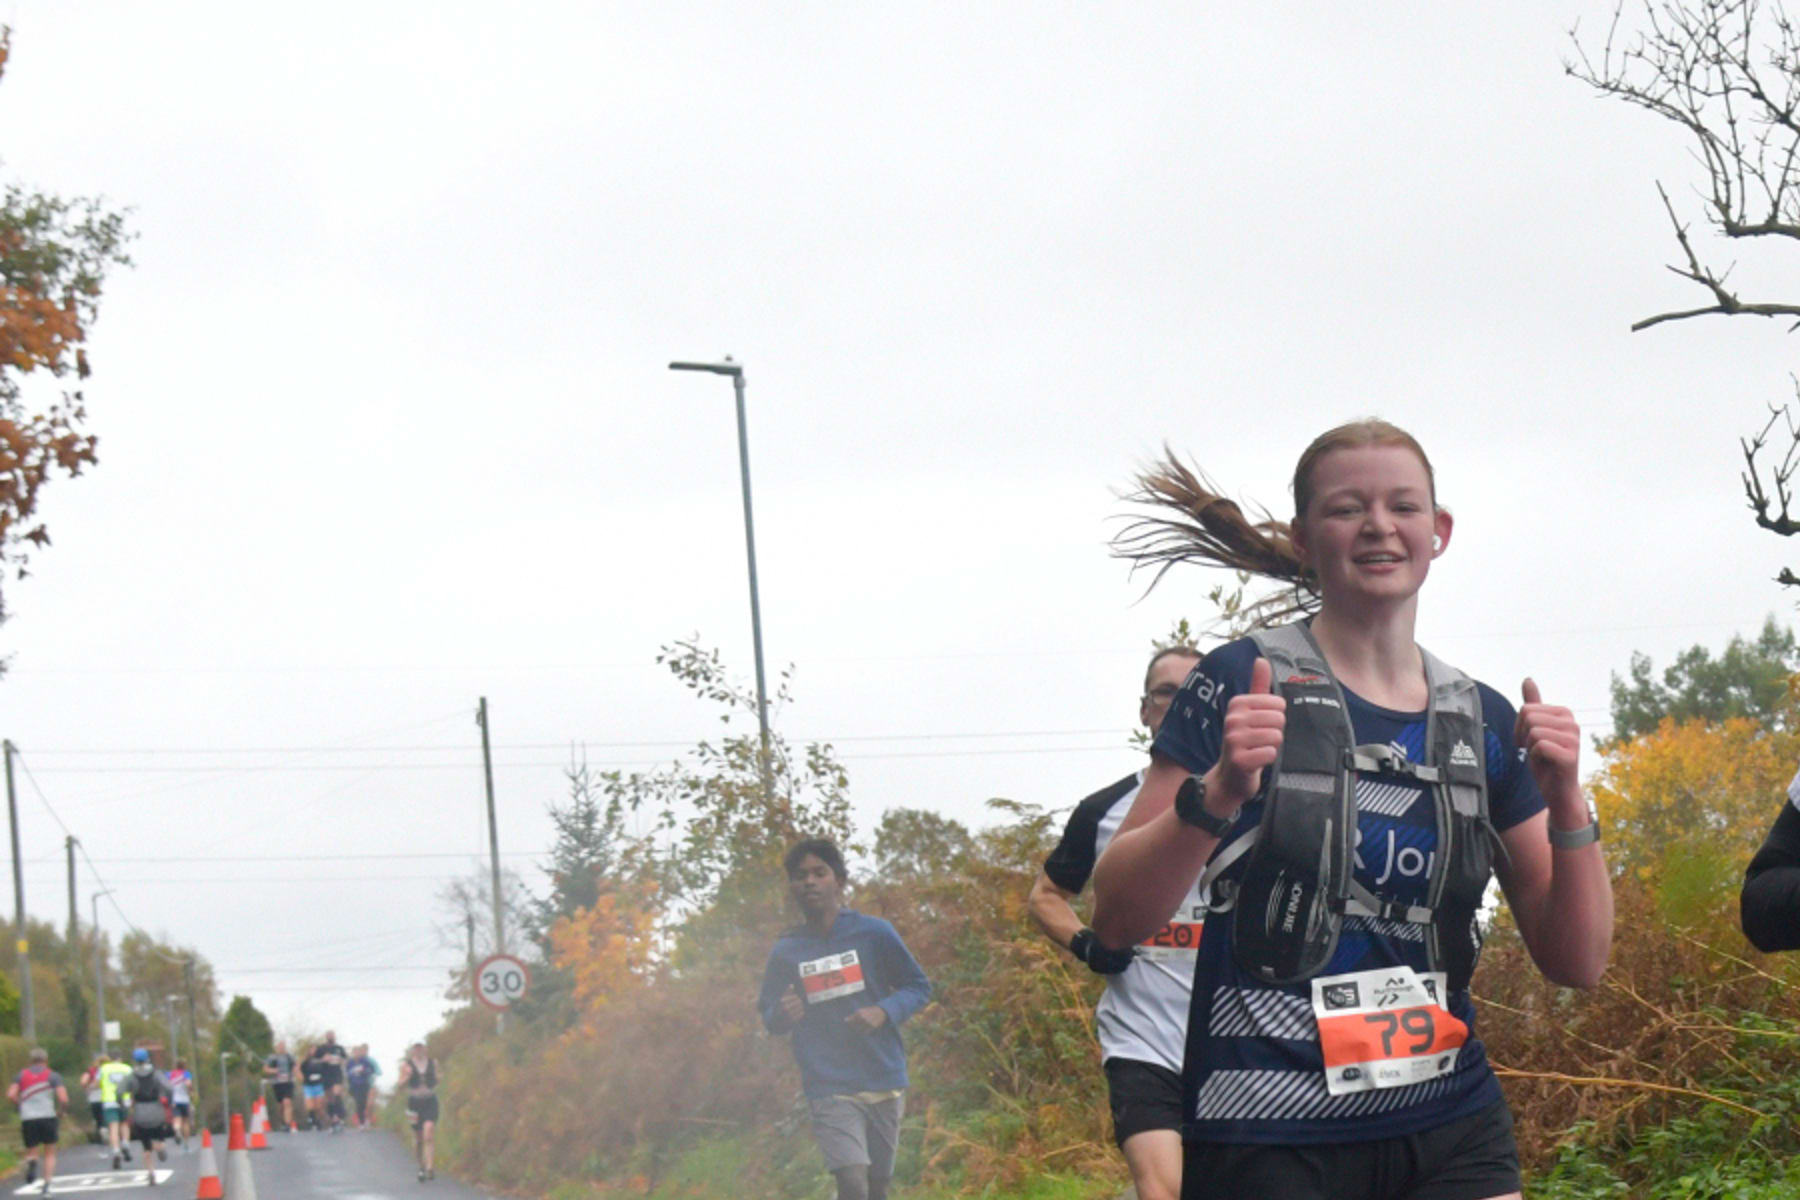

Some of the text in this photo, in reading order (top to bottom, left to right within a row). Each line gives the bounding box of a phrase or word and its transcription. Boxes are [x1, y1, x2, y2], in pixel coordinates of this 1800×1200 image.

[1154, 923, 1192, 947] 20
[483, 971, 521, 993] 30
[1364, 1009, 1434, 1056] 79
